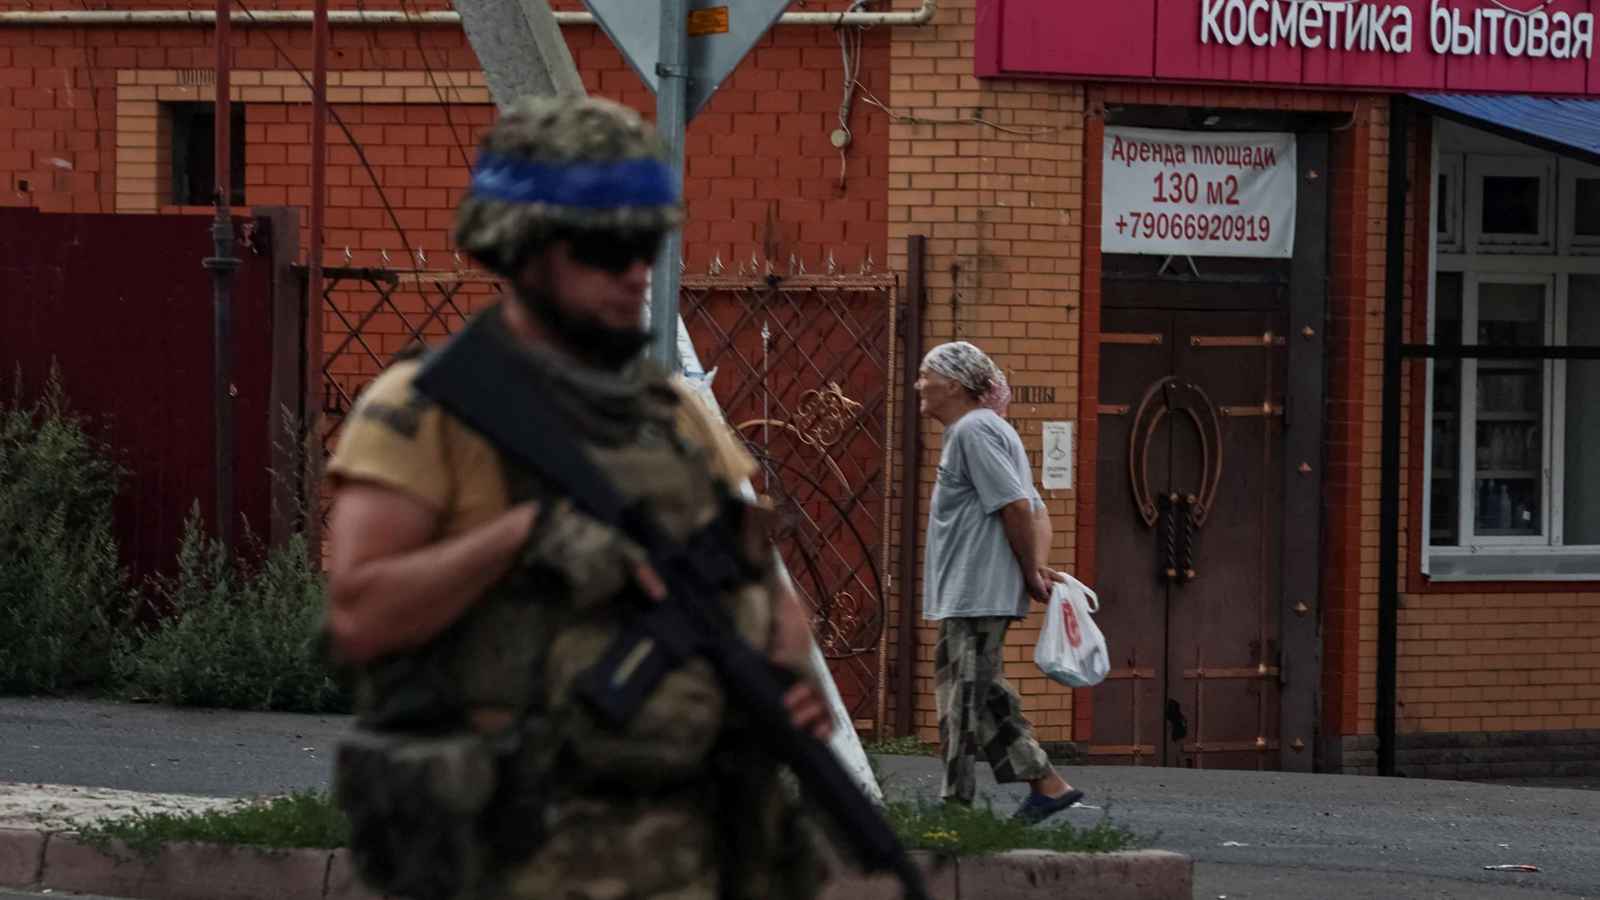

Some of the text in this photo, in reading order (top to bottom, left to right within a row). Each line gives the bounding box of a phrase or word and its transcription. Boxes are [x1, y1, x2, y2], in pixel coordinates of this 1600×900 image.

[1200, 0, 1594, 59] косметика бытовая
[1111, 135, 1277, 170] Аренда площади
[1152, 171, 1240, 206] 130 м2
[1115, 212, 1271, 242] +79066920919
